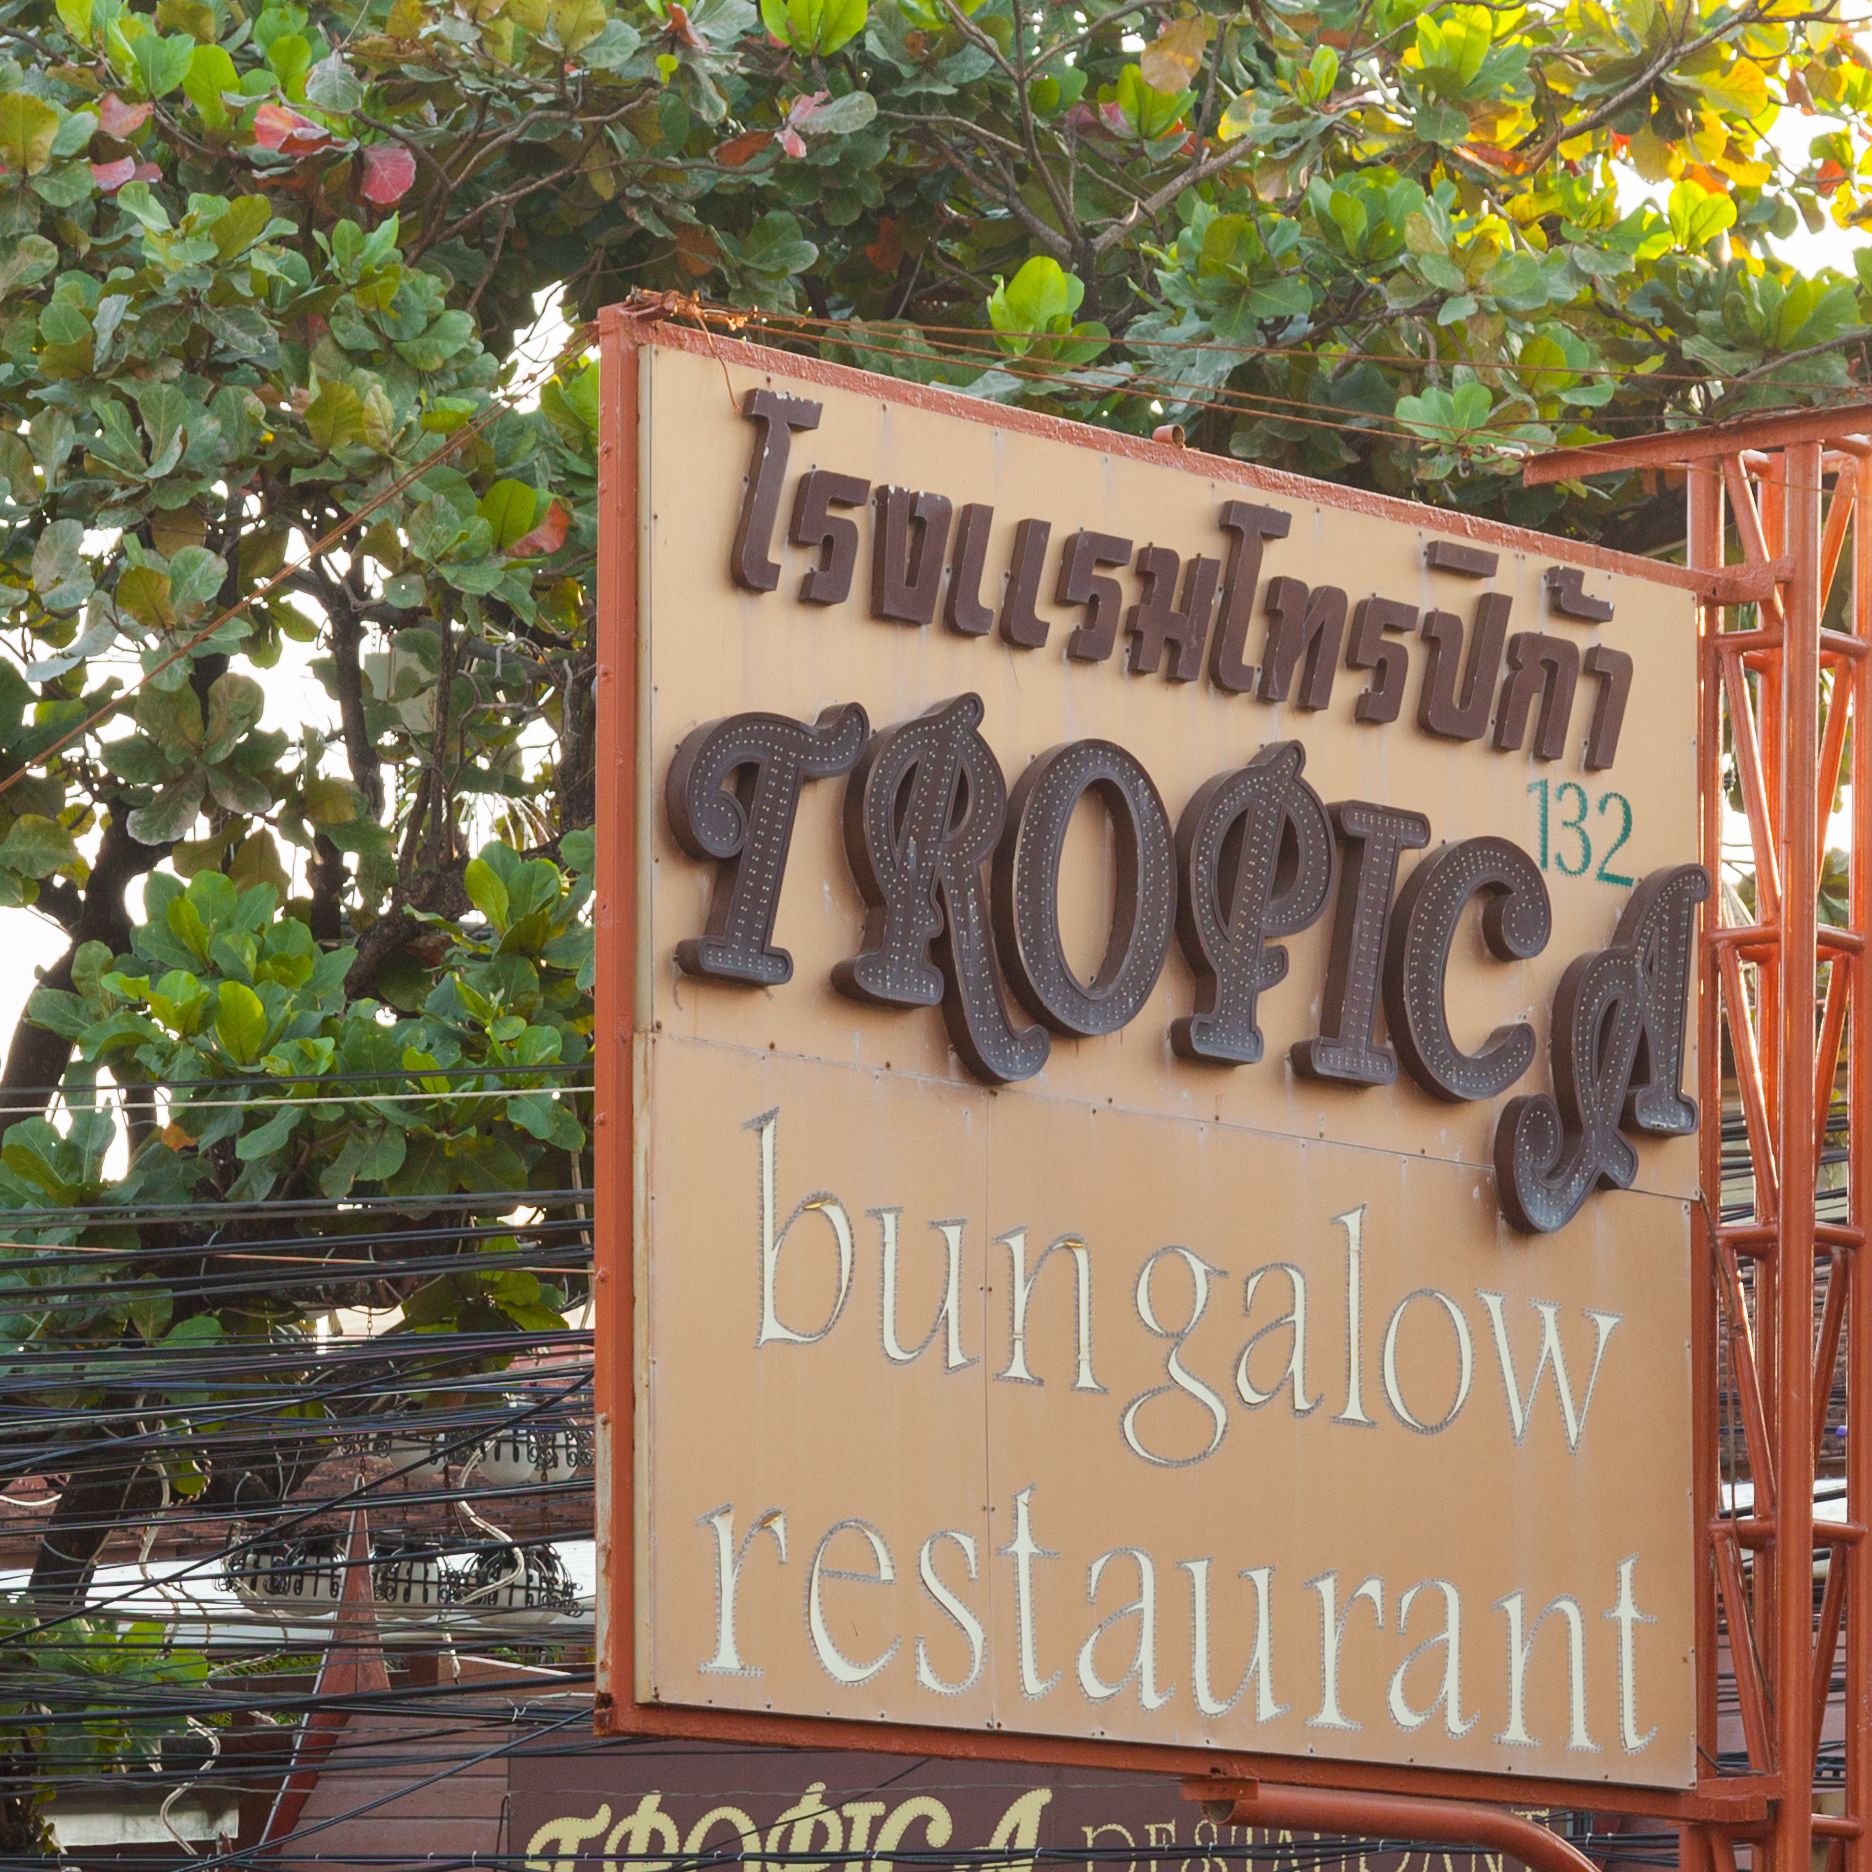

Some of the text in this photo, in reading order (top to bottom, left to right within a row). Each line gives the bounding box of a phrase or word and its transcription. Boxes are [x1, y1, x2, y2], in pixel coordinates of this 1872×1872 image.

[665, 691, 1711, 1234] TROPICA
[1526, 778, 1635, 888] 132
[744, 1105, 1624, 1468] bungalow
[695, 1482, 1659, 1756] restaurant
